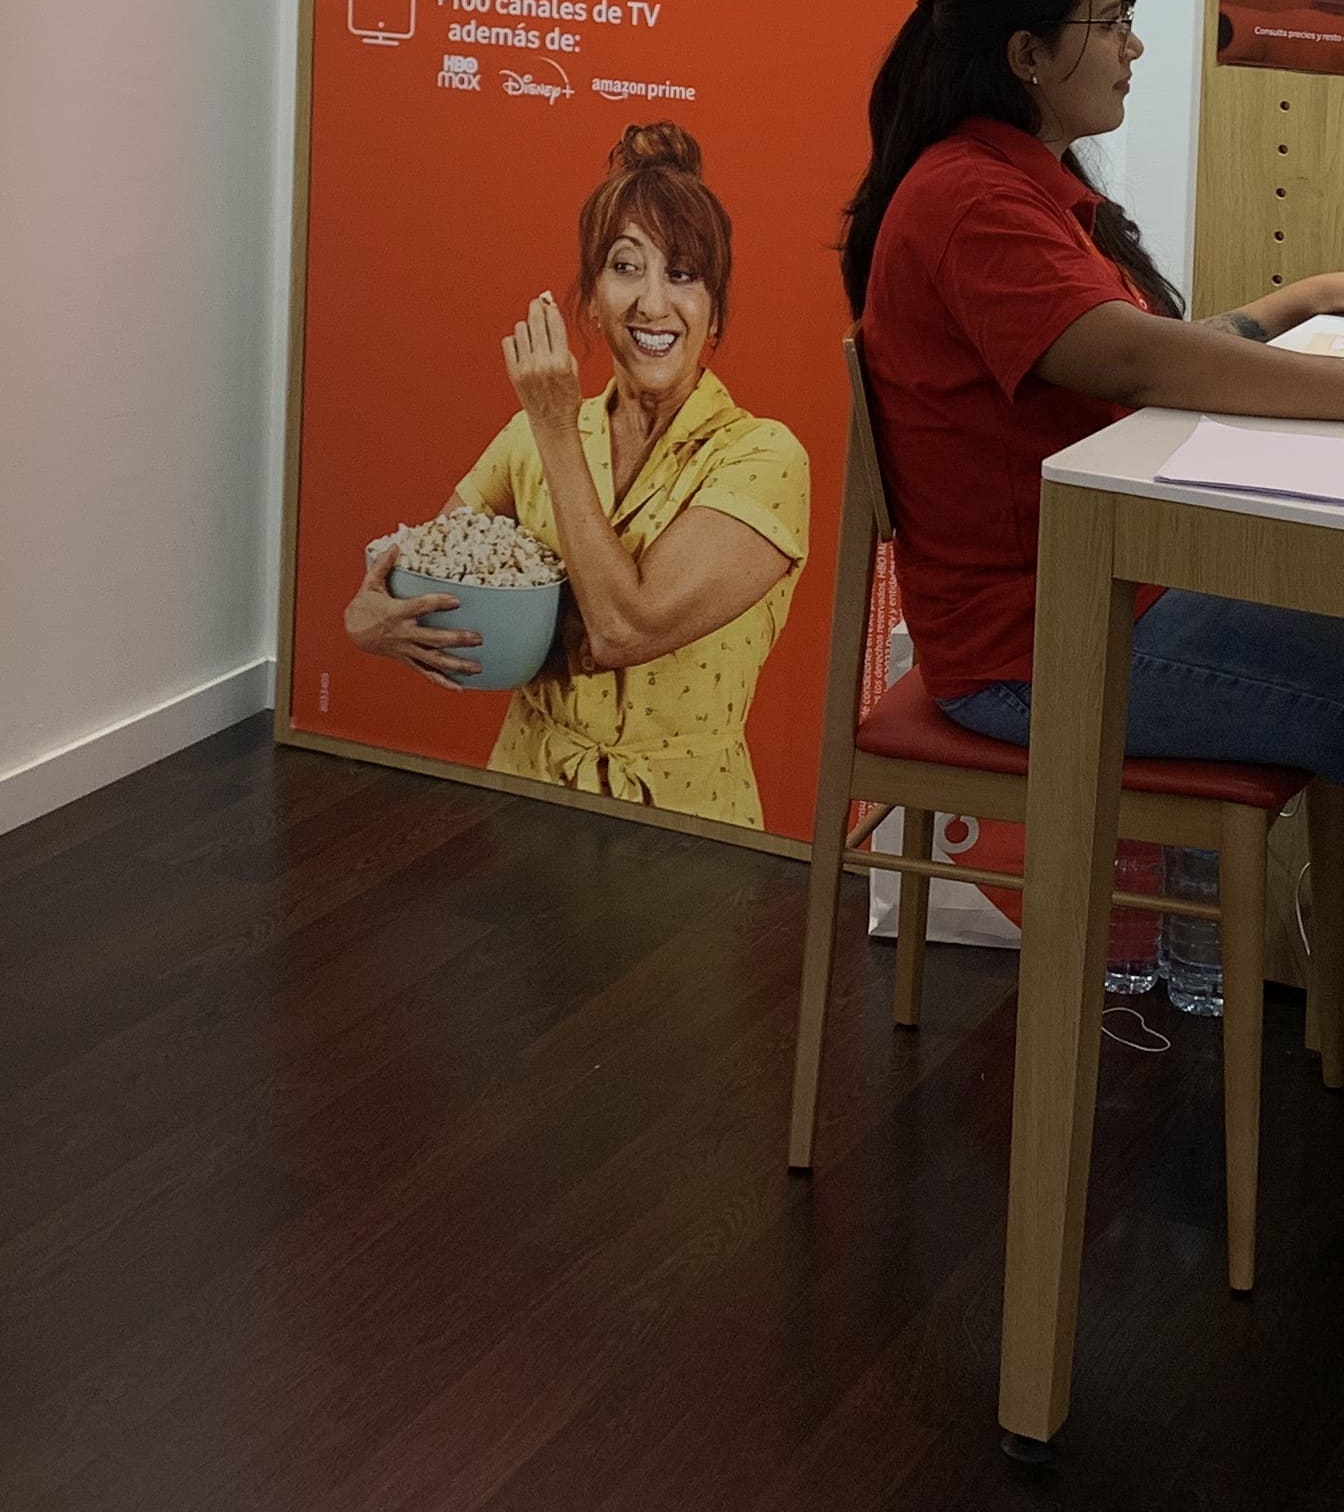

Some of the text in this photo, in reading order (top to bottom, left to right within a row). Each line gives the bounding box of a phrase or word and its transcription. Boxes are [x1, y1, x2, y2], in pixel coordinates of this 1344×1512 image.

[592, 0, 622, 24] de
[627, 1, 660, 27] TV
[448, 20, 580, 53] además de:
[1255, 26, 1288, 37] Consulta
[443, 55, 478, 73] HBO
[592, 78, 696, 101] amazon prime
[877, 556, 888, 579] HBO
[874, 635, 884, 677] derechos
